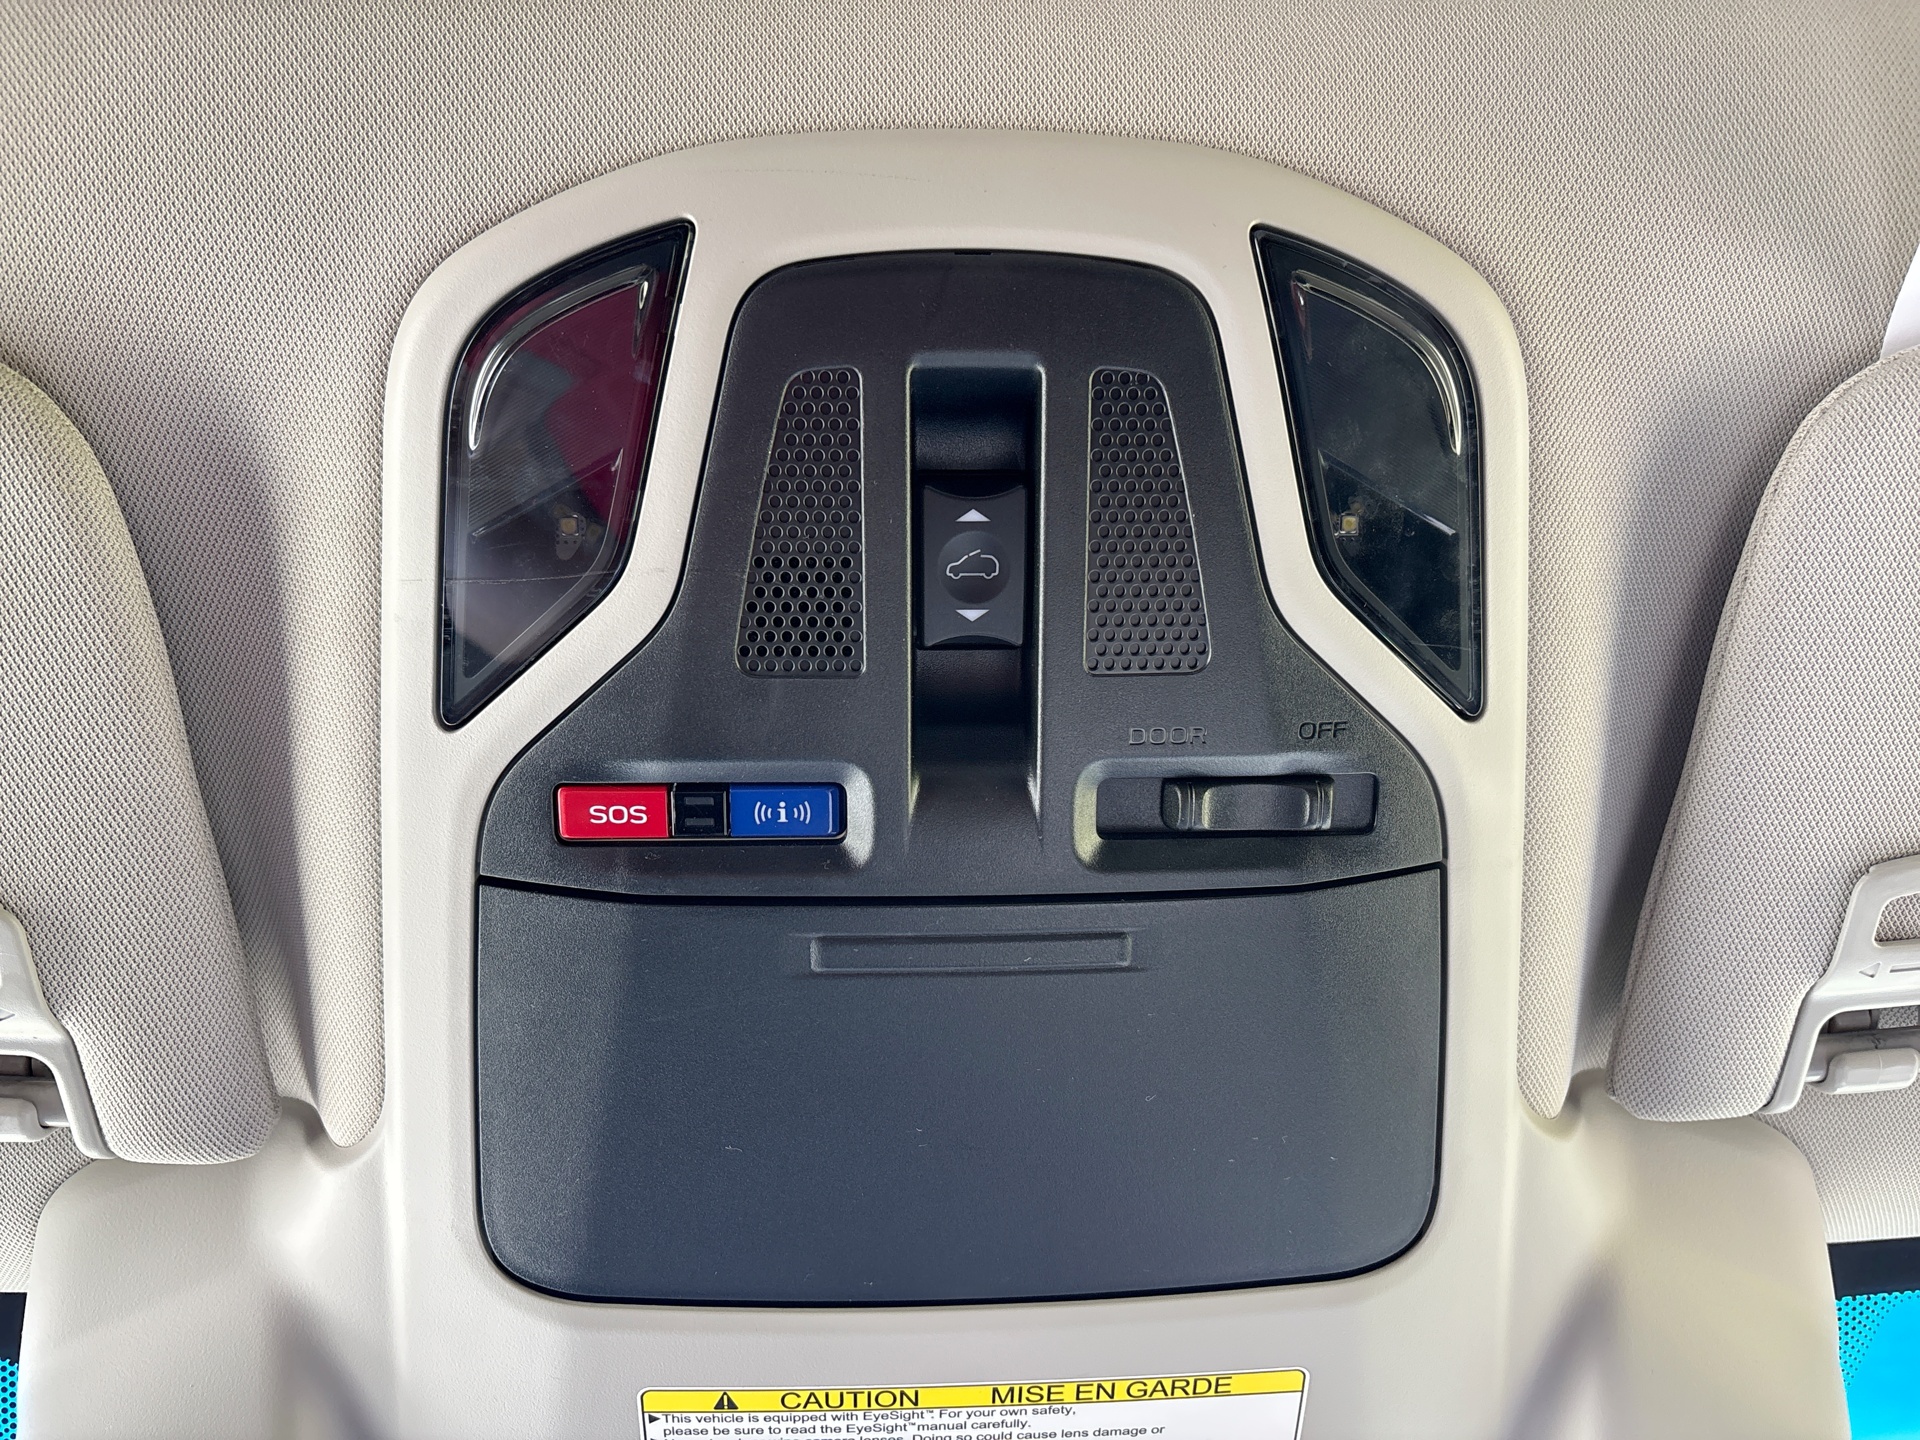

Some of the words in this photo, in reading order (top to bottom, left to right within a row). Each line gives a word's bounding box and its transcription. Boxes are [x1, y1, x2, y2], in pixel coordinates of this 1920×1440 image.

[1128, 726, 1208, 746] DOOR
[1297, 720, 1348, 740] OFF
[589, 805, 648, 824] SOS
[780, 1389, 920, 1410] CAUTION
[991, 1384, 1065, 1404] MISE
[1075, 1382, 1116, 1401] EN
[1125, 1376, 1233, 1399] GARDE
[662, 1413, 692, 1423] This
[695, 1413, 744, 1423] vehicle
[748, 1413, 760, 1423] is
[763, 1412, 827, 1424] equipped
[831, 1411, 859, 1421] with
[939, 1409, 962, 1419] For
[966, 1409, 996, 1420] your
[999, 1408, 1028, 1417] own
[1031, 1405, 1076, 1416] safety,
[663, 1426, 709, 1438] please
[713, 1426, 730, 1436] be
[734, 1427, 764, 1436] sure
[768, 1425, 782, 1435] to
[785, 1424, 816, 1434] read
[820, 1424, 842, 1434] the
[917, 1420, 967, 1431] manual
[971, 1419, 1032, 1429] carefully.
[976, 1431, 1013, 1440] could
[1016, 1430, 1057, 1440] cause
[1061, 1429, 1089, 1438] lens
[1092, 1427, 1147, 1437] damage
[1151, 1426, 1166, 1435] or
